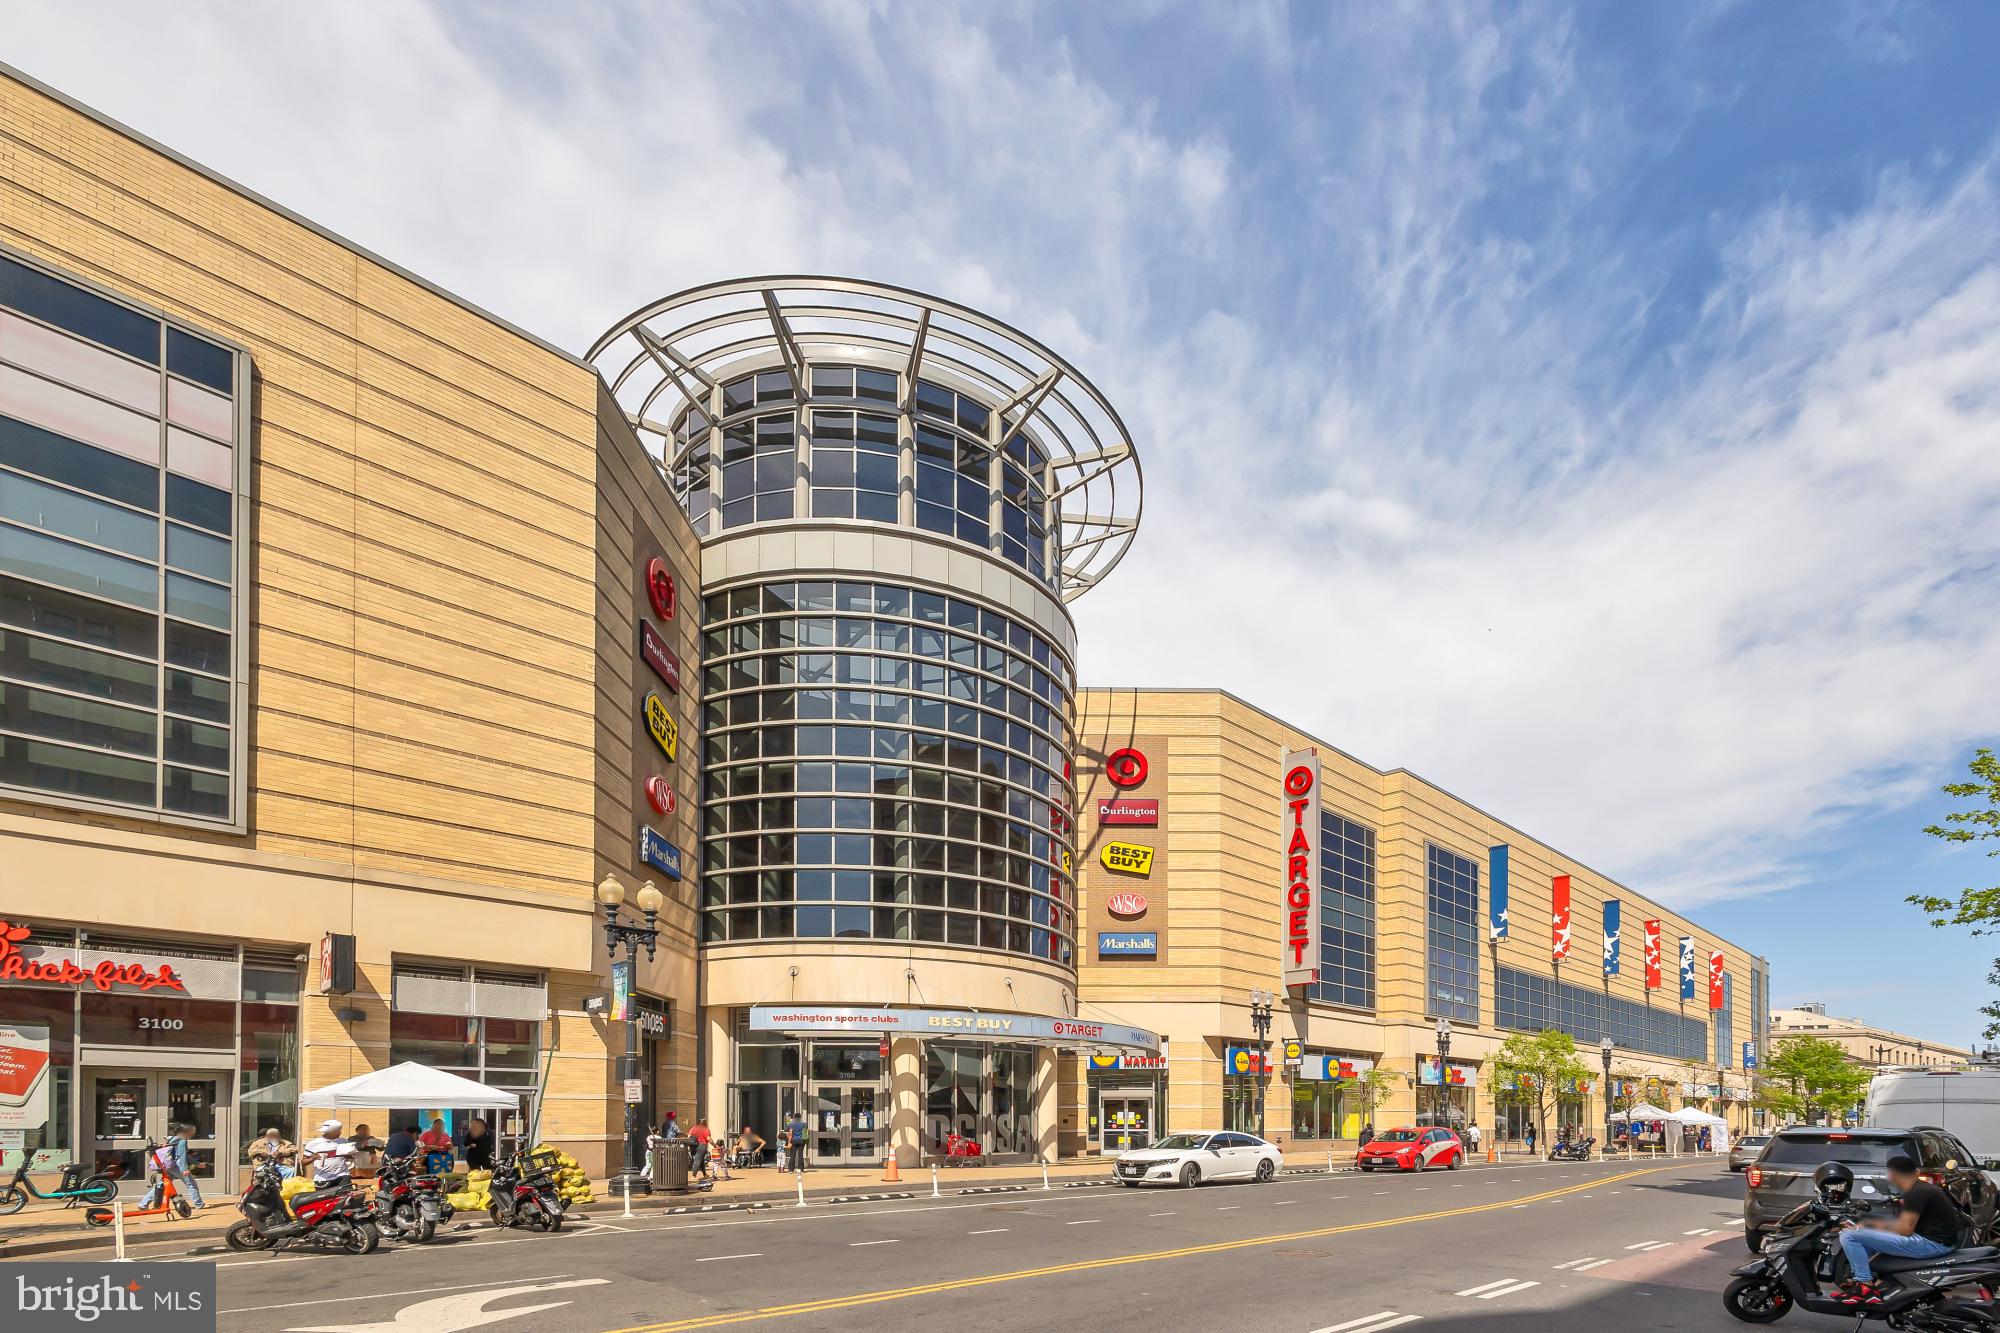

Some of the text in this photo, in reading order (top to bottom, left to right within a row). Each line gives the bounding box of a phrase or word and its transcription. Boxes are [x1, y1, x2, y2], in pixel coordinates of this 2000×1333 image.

[653, 701, 676, 738] BEST
[652, 715, 673, 749] BUY
[656, 780, 673, 811] WSC
[1100, 805, 1156, 817] Burlington
[1109, 845, 1150, 859] BEST
[1109, 856, 1145, 869] BUY
[1288, 798, 1310, 965] TARGET
[1111, 894, 1142, 907] WSC
[1100, 937, 1155, 950] Marshalls
[138, 1017, 183, 1030] 3100
[772, 1013, 899, 1024] washington sports clubs
[928, 1016, 1013, 1030] BEST BUY
[1065, 1023, 1103, 1037] TARGET
